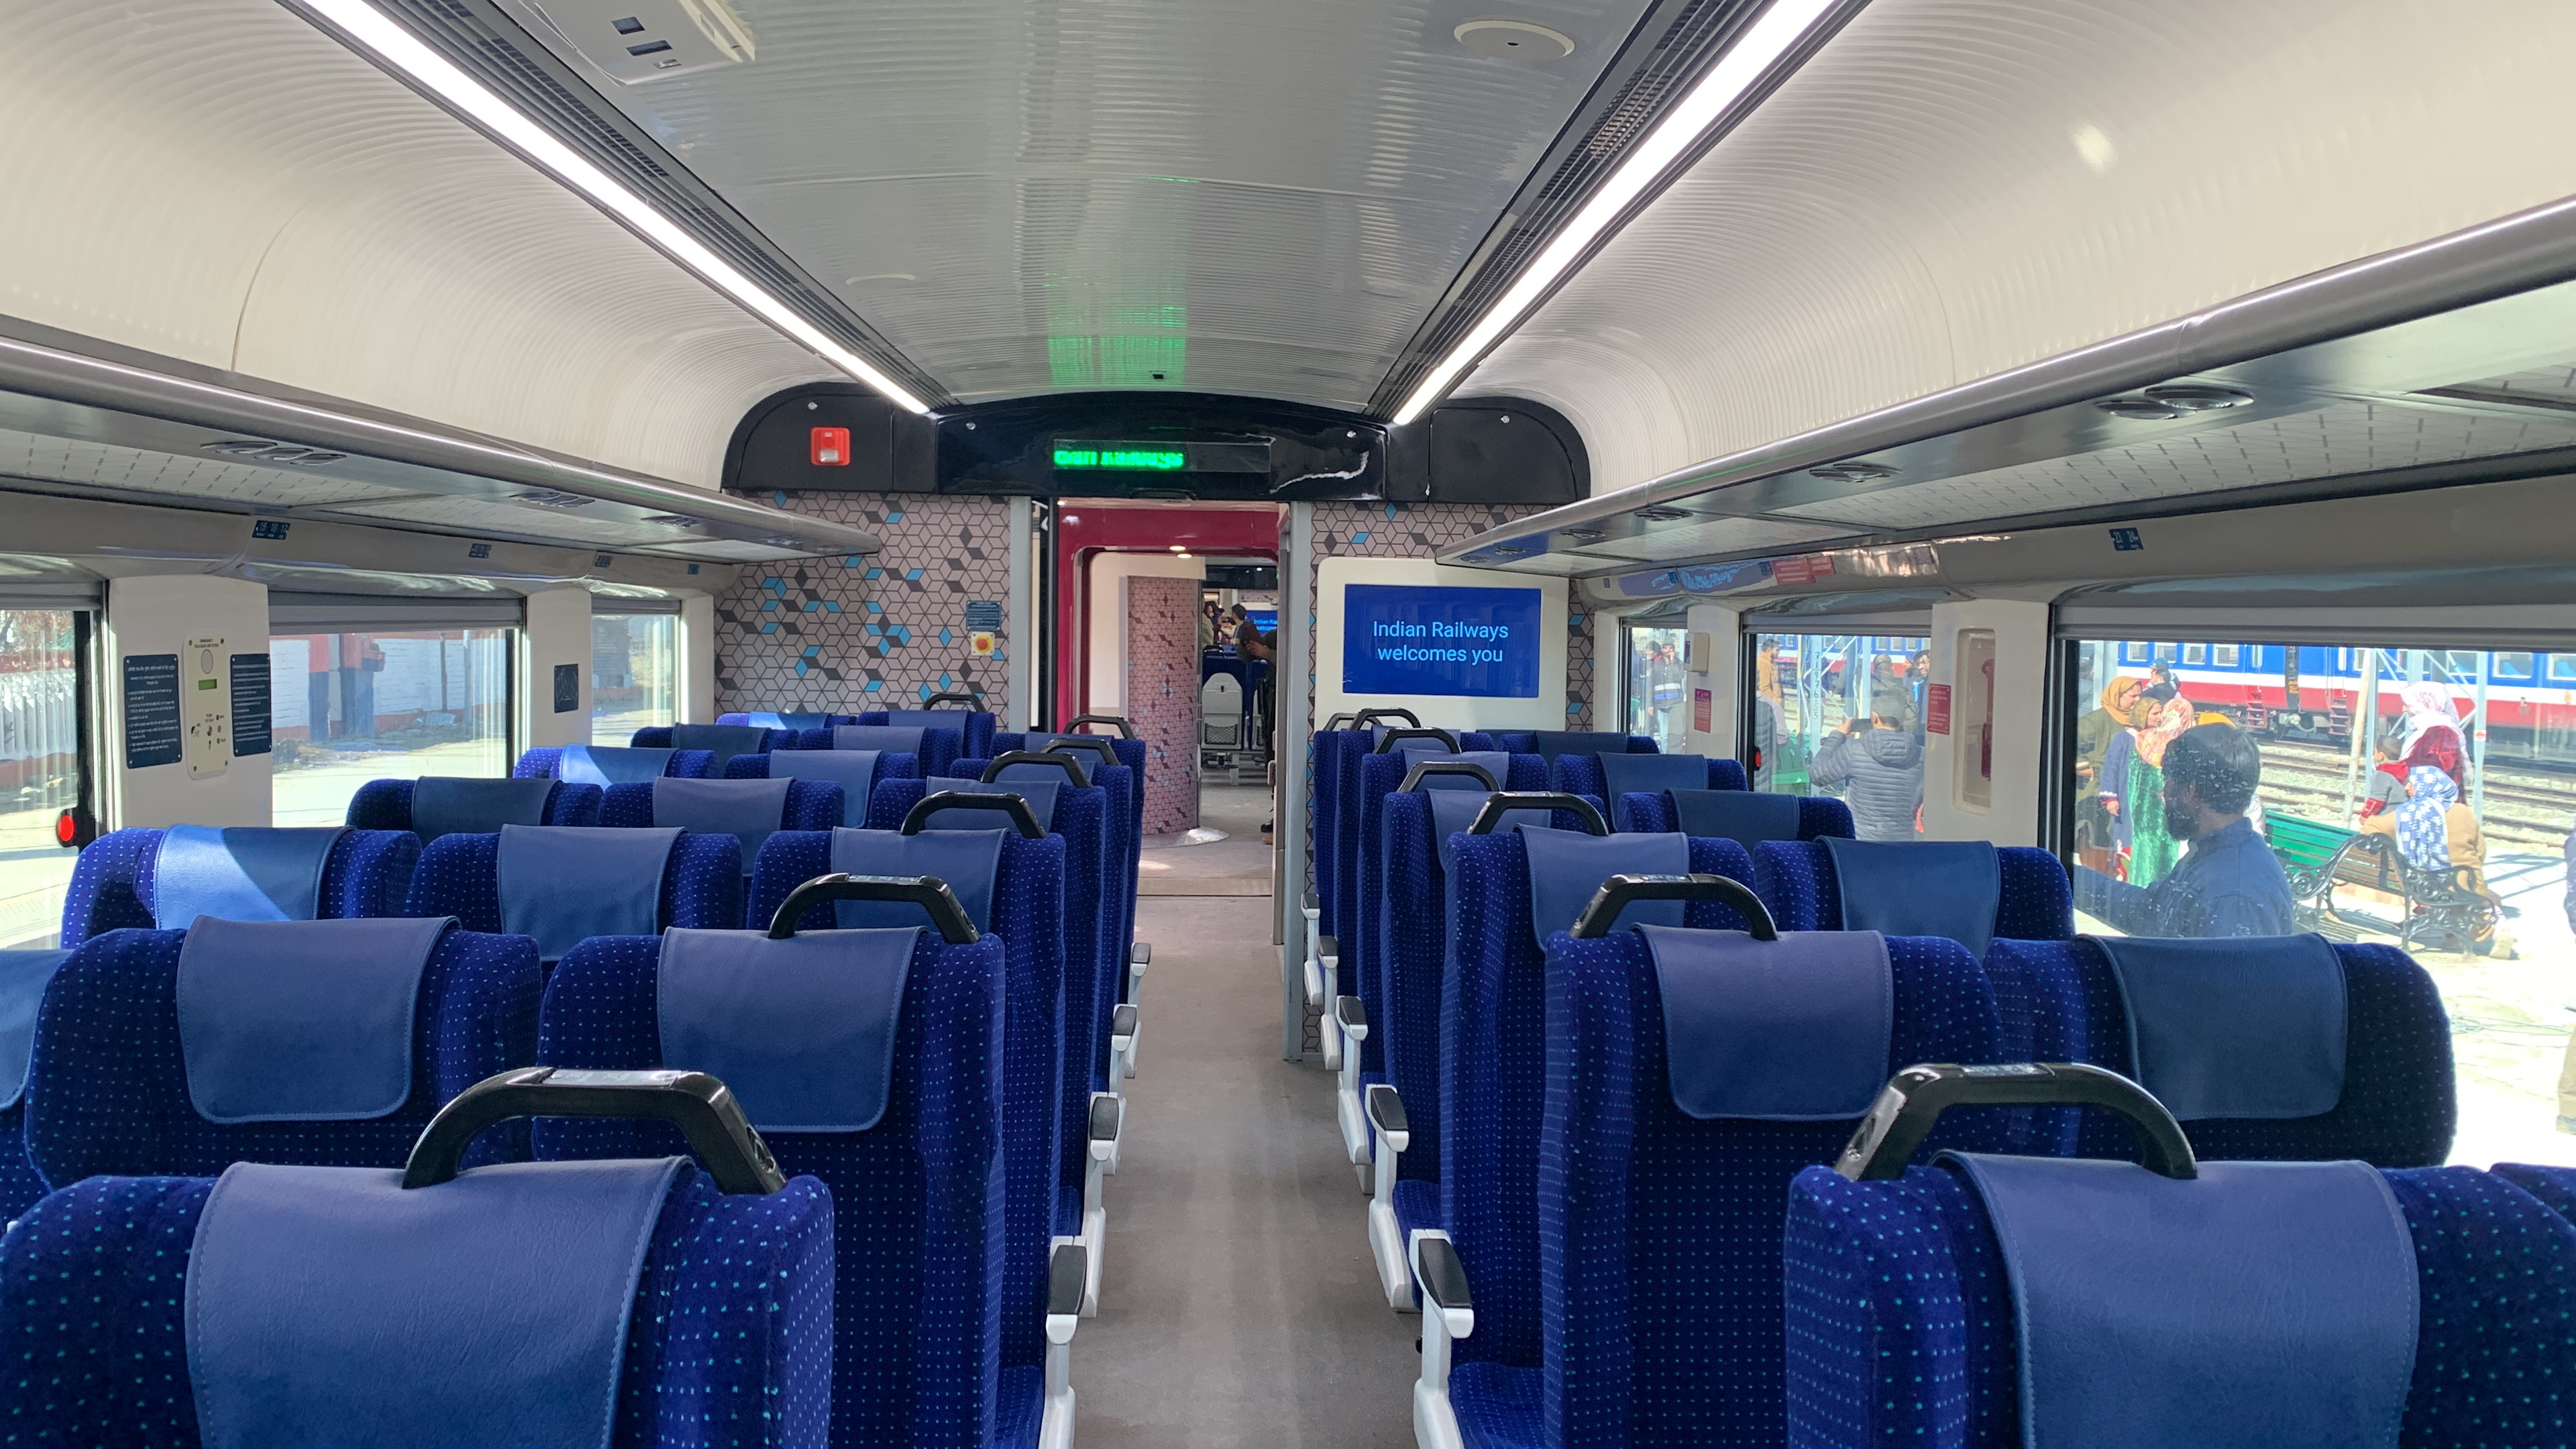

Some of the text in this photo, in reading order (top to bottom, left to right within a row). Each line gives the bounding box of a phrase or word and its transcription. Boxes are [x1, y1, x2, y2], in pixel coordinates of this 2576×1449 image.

[1374, 621, 1509, 642] Indian Railways
[1377, 644, 1503, 665] welcomes you
